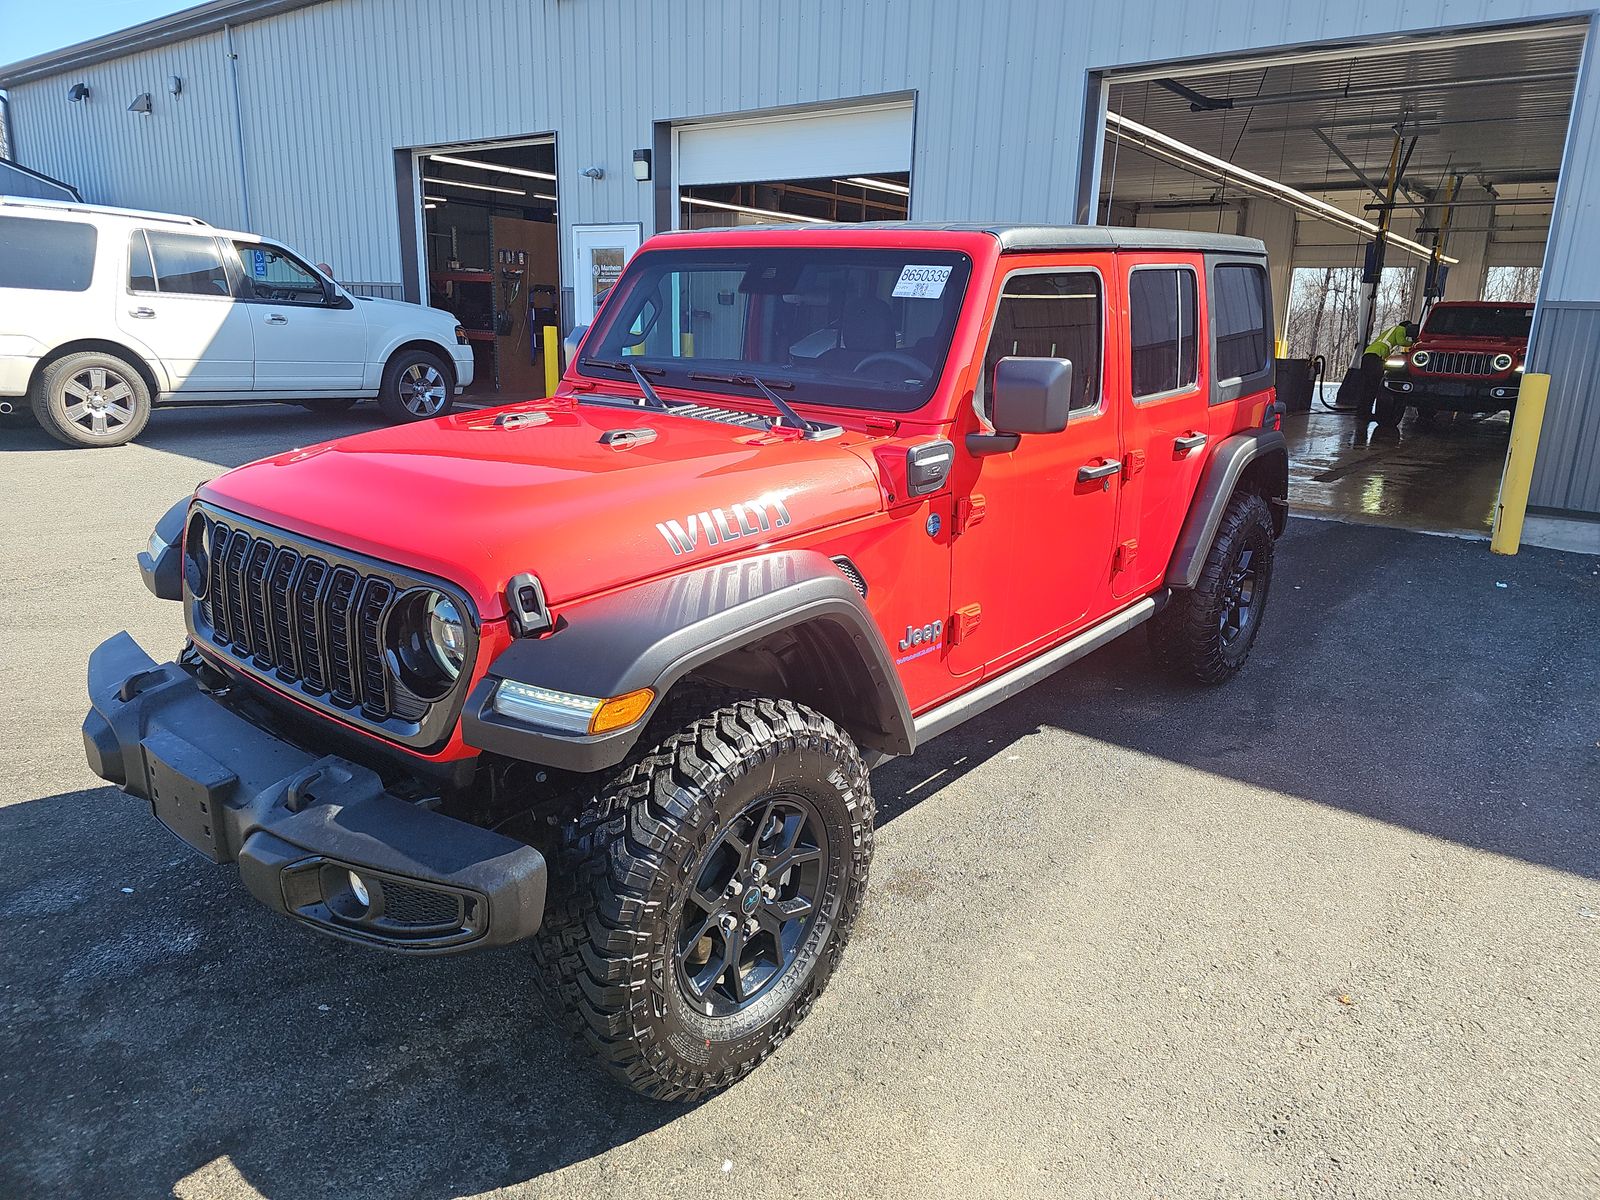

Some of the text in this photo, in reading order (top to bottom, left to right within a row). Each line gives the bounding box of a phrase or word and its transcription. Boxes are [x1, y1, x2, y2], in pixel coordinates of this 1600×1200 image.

[901, 269, 949, 282] 8650339
[656, 498, 791, 555] WILLYS
[899, 619, 943, 651] Jeep
